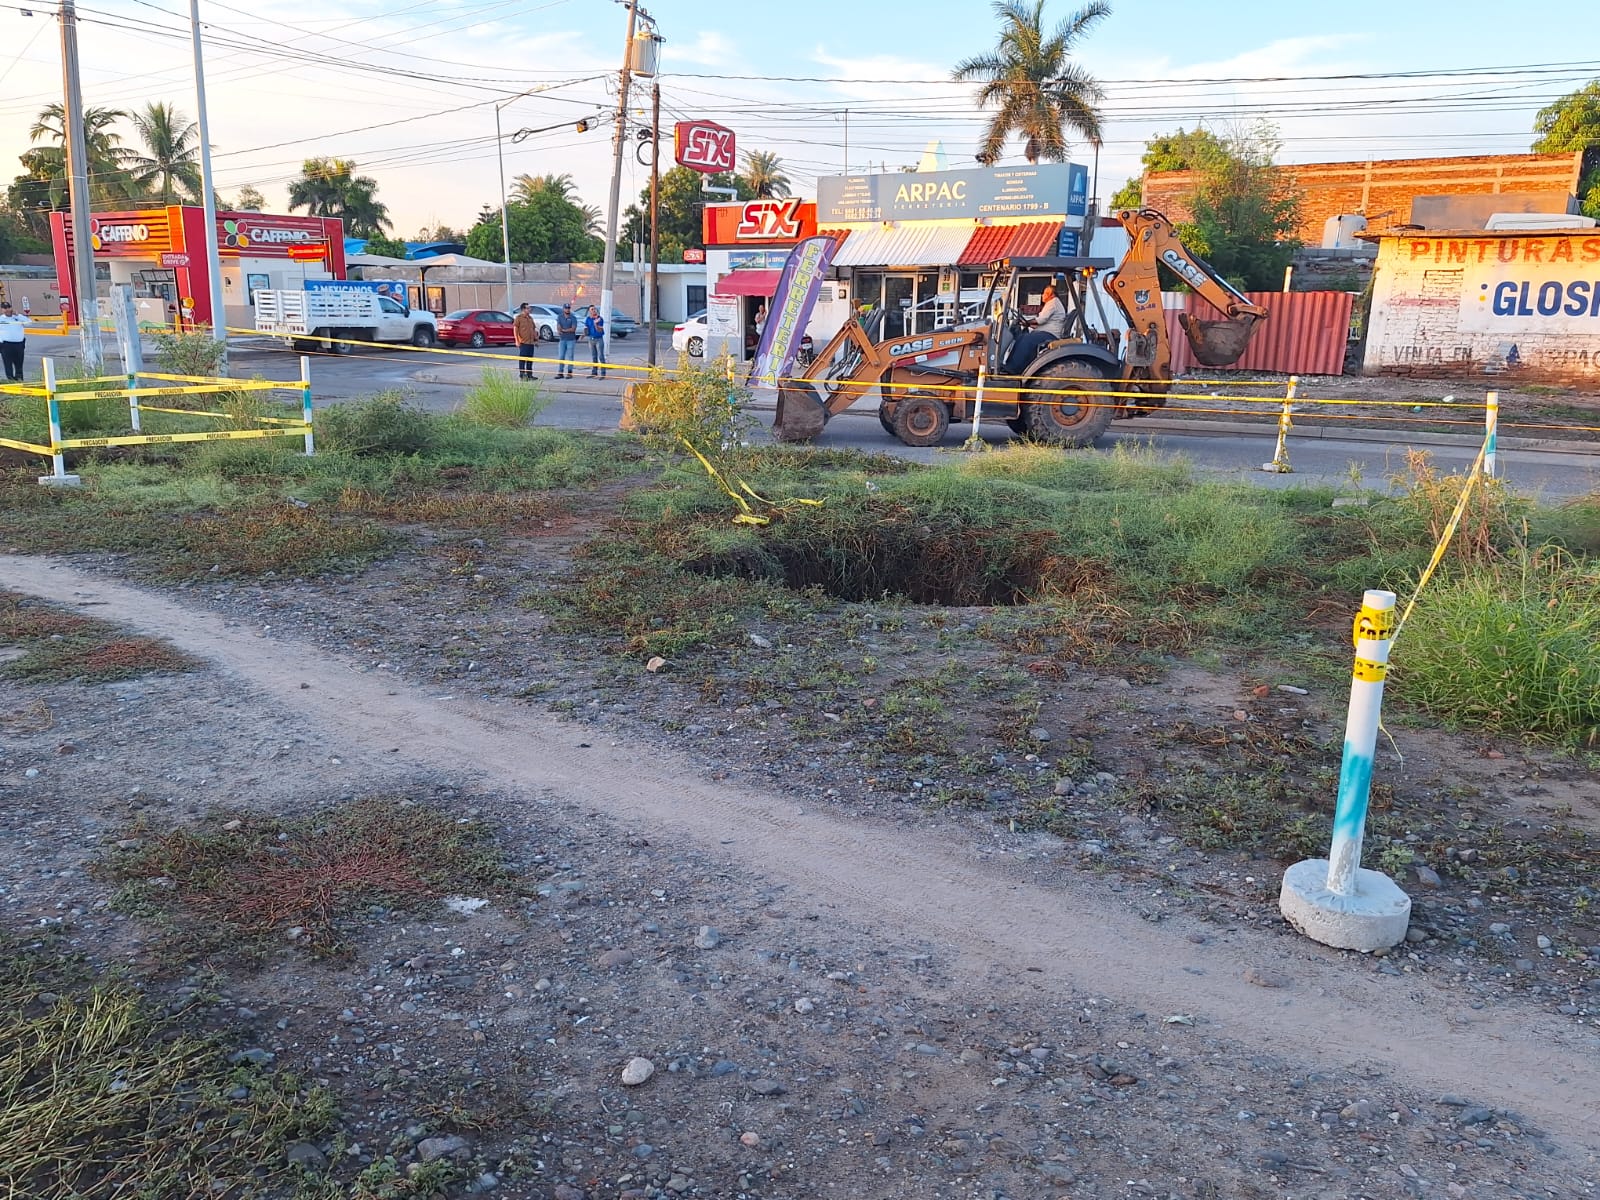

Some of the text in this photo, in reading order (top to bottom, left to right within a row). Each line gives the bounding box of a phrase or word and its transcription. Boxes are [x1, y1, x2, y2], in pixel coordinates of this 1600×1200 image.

[894, 180, 967, 203] ARPAC
[979, 204, 1022, 213] CENTENARIO
[1410, 238, 1600, 263] PINTURAS
[1163, 249, 1204, 287] CASE
[761, 242, 821, 387] FERRETERIA
[890, 337, 934, 356] CASE
